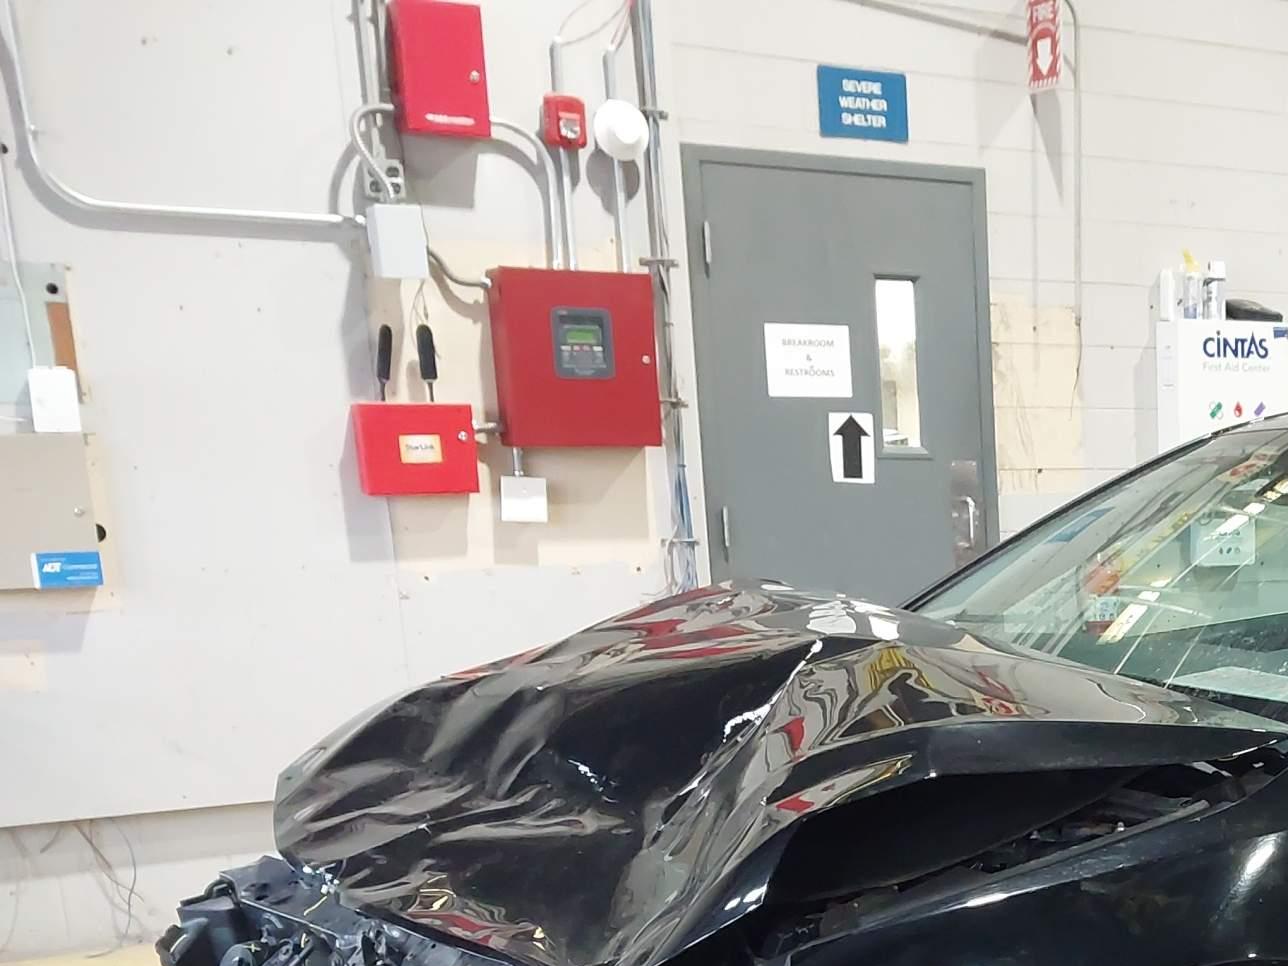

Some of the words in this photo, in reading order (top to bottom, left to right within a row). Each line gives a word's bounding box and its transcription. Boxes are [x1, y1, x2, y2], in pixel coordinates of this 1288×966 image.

[842, 78, 882, 95] SEVERE
[838, 95, 888, 112] WEATHER
[841, 112, 887, 128] SHELTER
